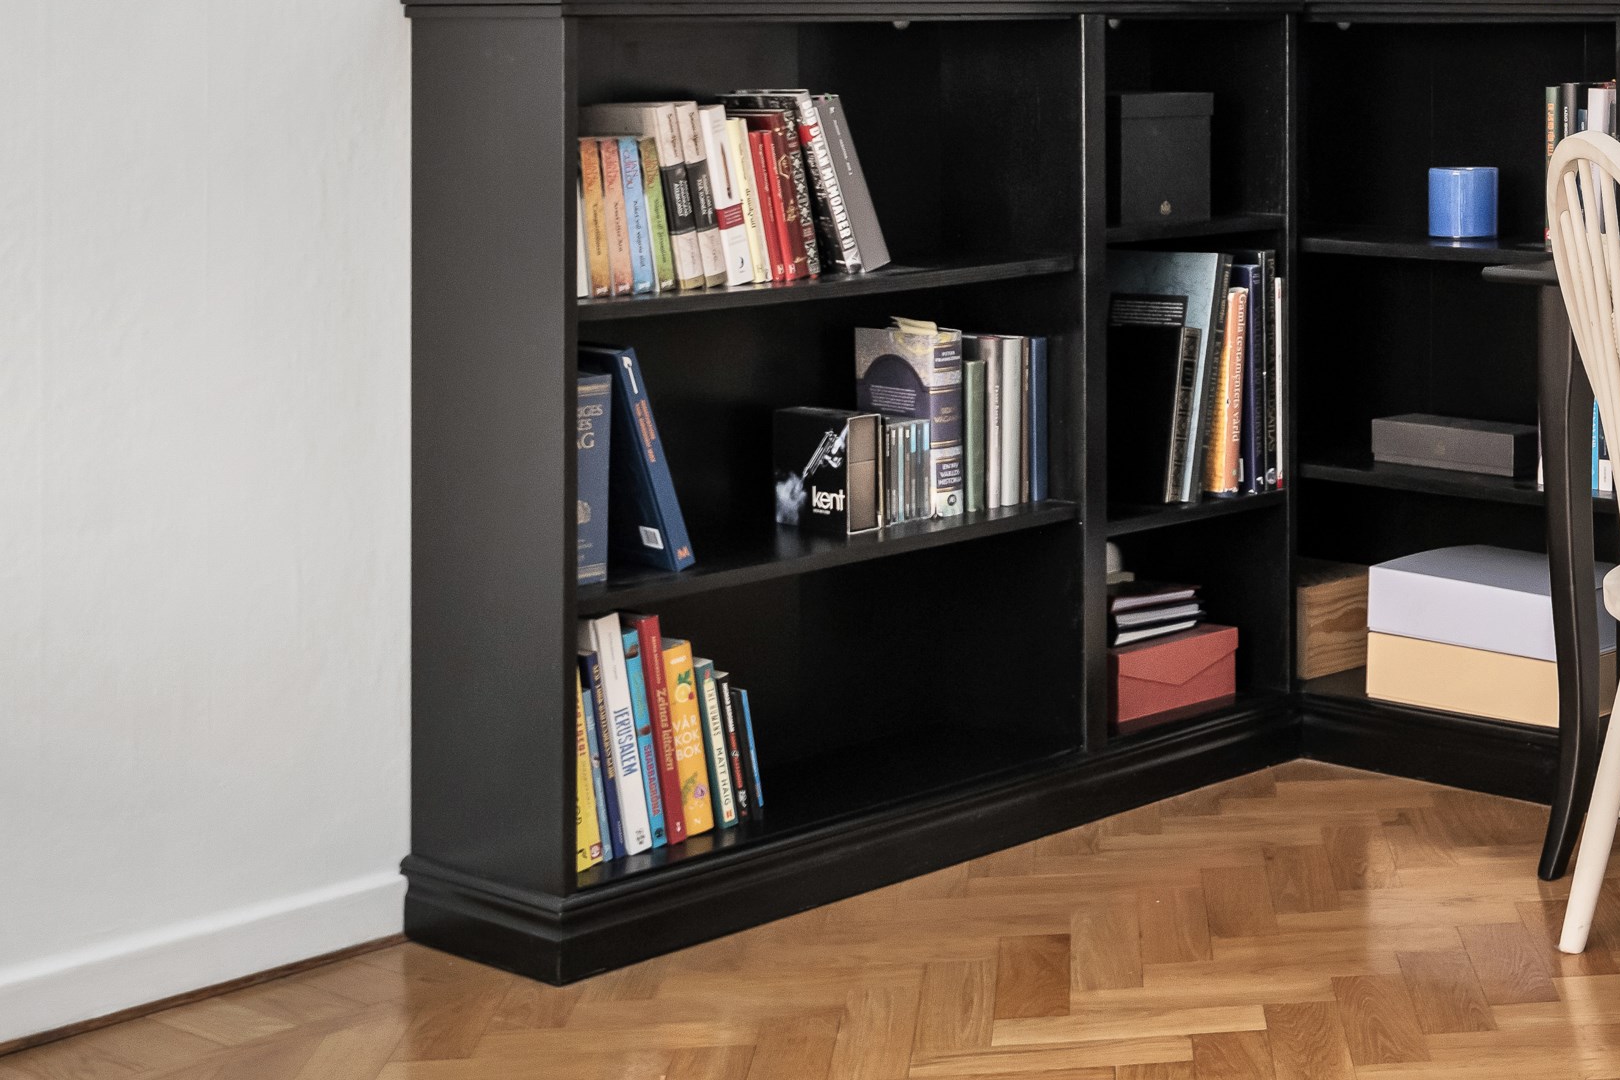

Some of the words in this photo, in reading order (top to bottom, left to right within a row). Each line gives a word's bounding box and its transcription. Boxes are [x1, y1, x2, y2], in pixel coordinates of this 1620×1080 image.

[800, 99, 818, 126] BOB
[807, 125, 830, 167] DYLAN
[819, 166, 851, 239] MEMOARER
[1237, 293, 1247, 332] Gamla
[1231, 335, 1245, 409] testamentets
[1231, 411, 1241, 442] värld
[812, 485, 845, 511] kent
[706, 688, 716, 701] THE
[655, 687, 668, 727] Zeinas
[662, 728, 674, 771] kitchen
[672, 714, 697, 733] VÅR
[613, 706, 639, 777] JERUSALEM
[674, 730, 699, 746] KOK
[675, 745, 701, 761] BOK
[715, 747, 727, 775] MATT
[719, 778, 731, 806] HAIG
